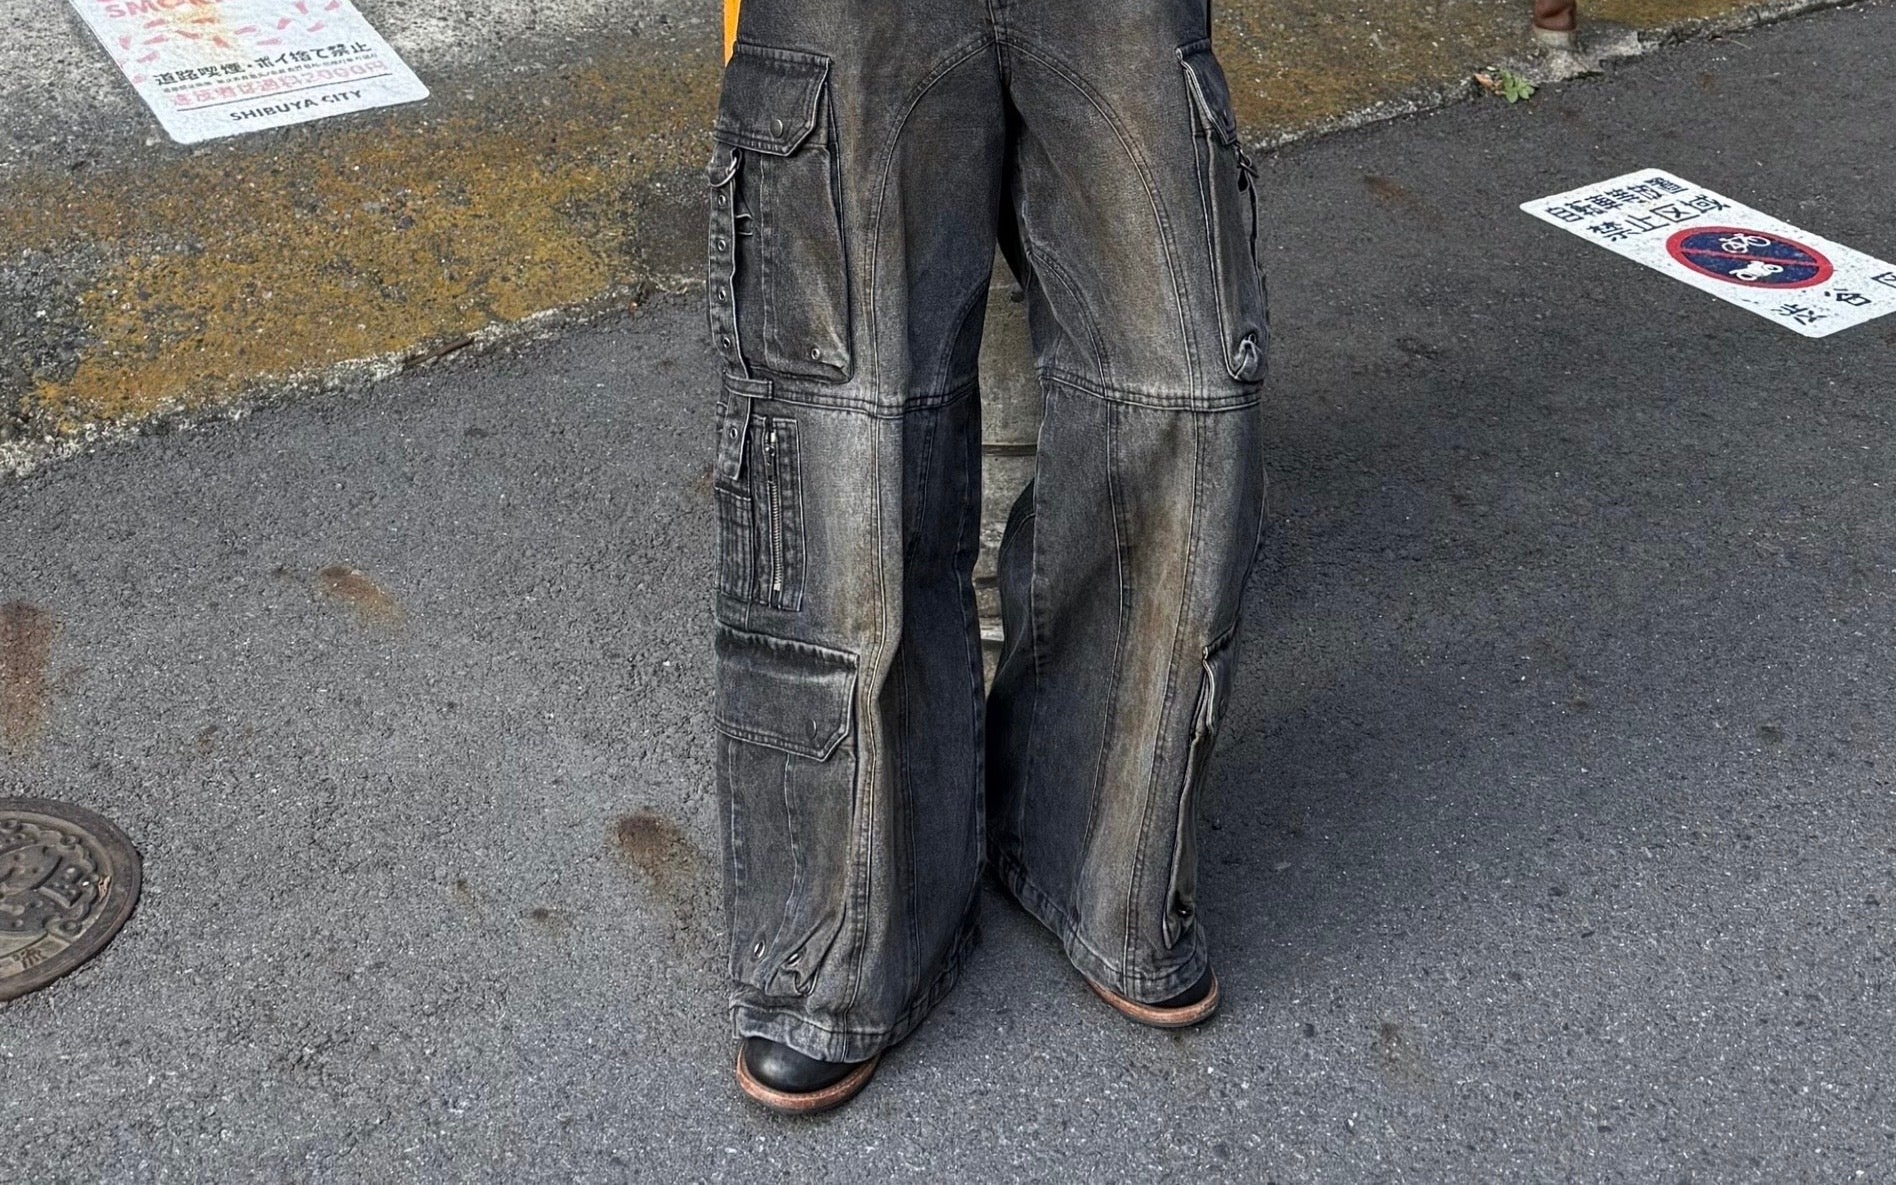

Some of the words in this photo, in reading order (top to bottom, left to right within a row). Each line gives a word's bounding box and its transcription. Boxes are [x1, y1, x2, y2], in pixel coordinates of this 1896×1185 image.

[230, 97, 319, 122] SHIBUYA
[321, 89, 363, 105] CITY
[1546, 177, 1689, 223] 自転車等放置
[1586, 194, 1731, 242] 禁止区域
